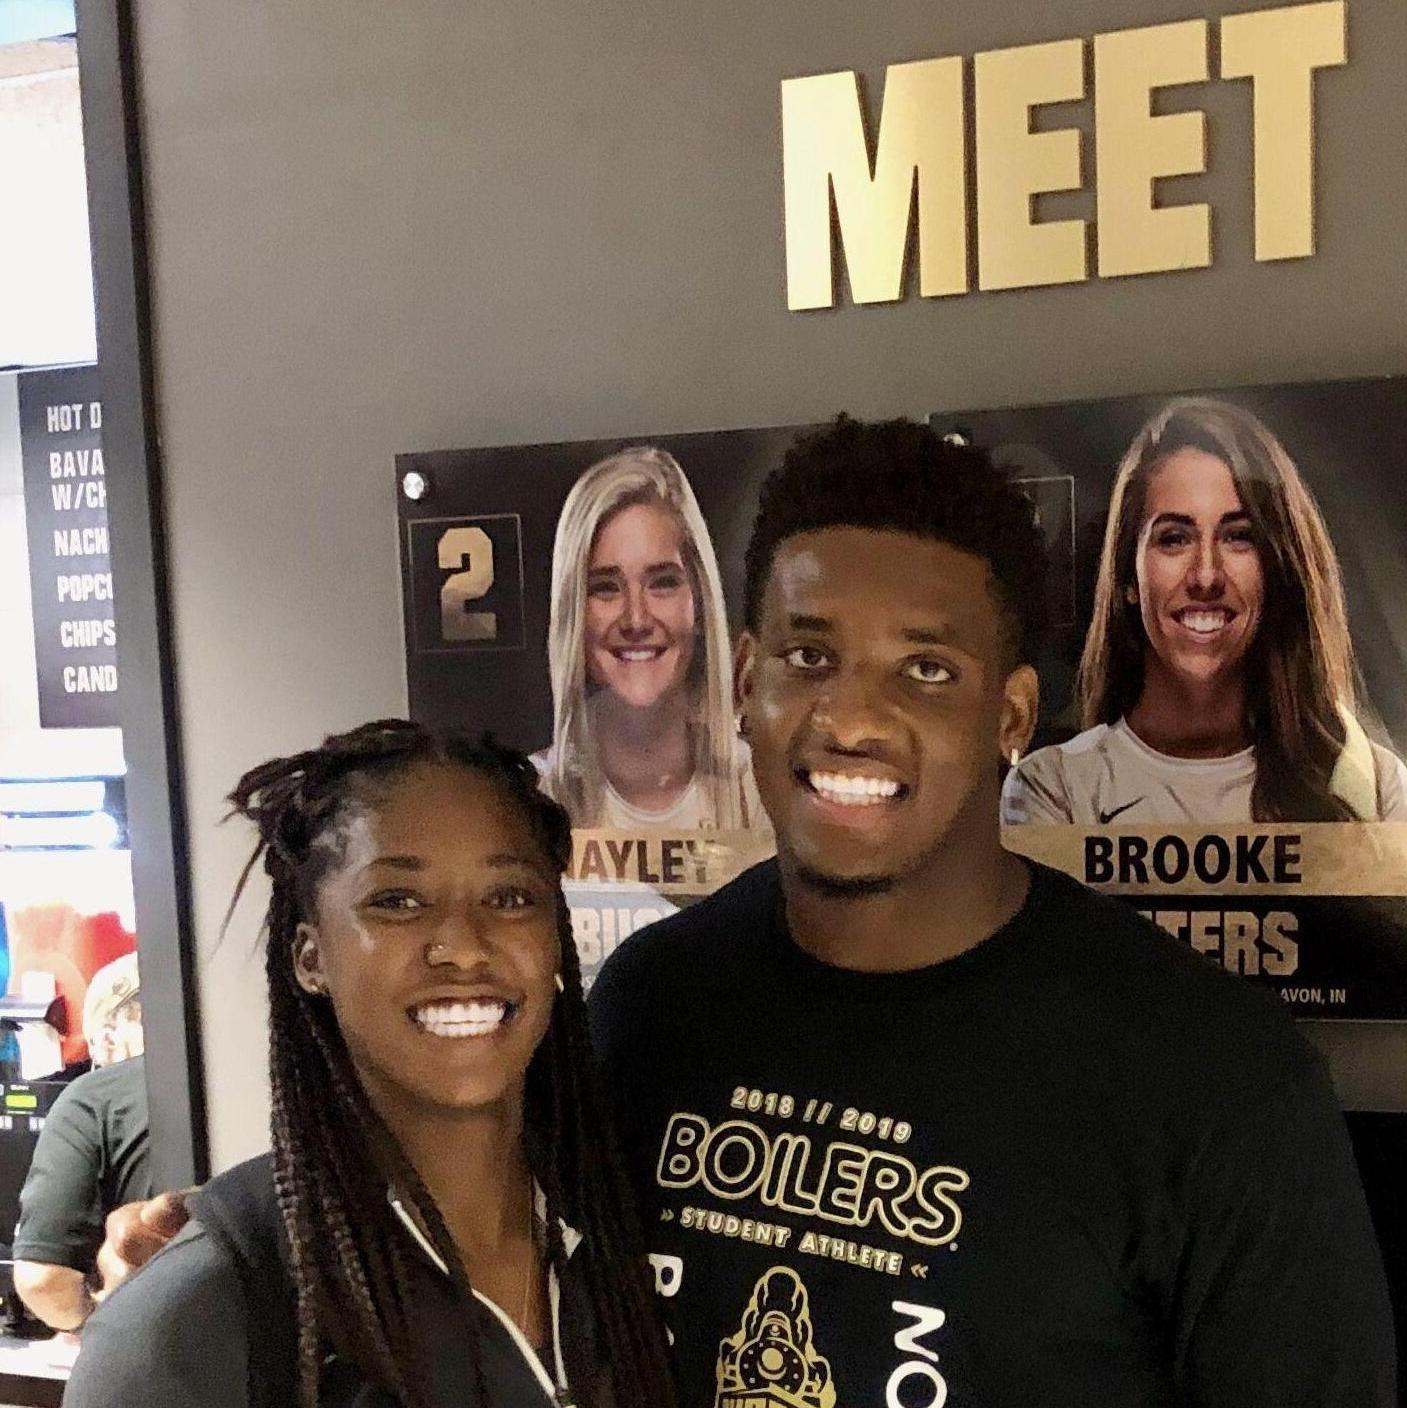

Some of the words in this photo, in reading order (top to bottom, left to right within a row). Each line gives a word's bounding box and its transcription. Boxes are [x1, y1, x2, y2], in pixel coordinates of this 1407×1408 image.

[781, 0, 1348, 311] MEET
[47, 404, 83, 433] HOT
[50, 449, 105, 479] BAVA
[54, 527, 110, 557] NACH
[437, 526, 497, 641] 2
[60, 619, 116, 648] CHIPS
[63, 665, 118, 693] CAND
[568, 839, 715, 884] AYLEY
[1084, 835, 1303, 884] BROOKE
[1329, 989, 1346, 1004] IN
[731, 1086, 795, 1119] 2018
[839, 1107, 912, 1144] 2019
[657, 1112, 970, 1247] BOILERS
[680, 1206, 792, 1248] STUDENT
[799, 1231, 904, 1276] ATHLETE
